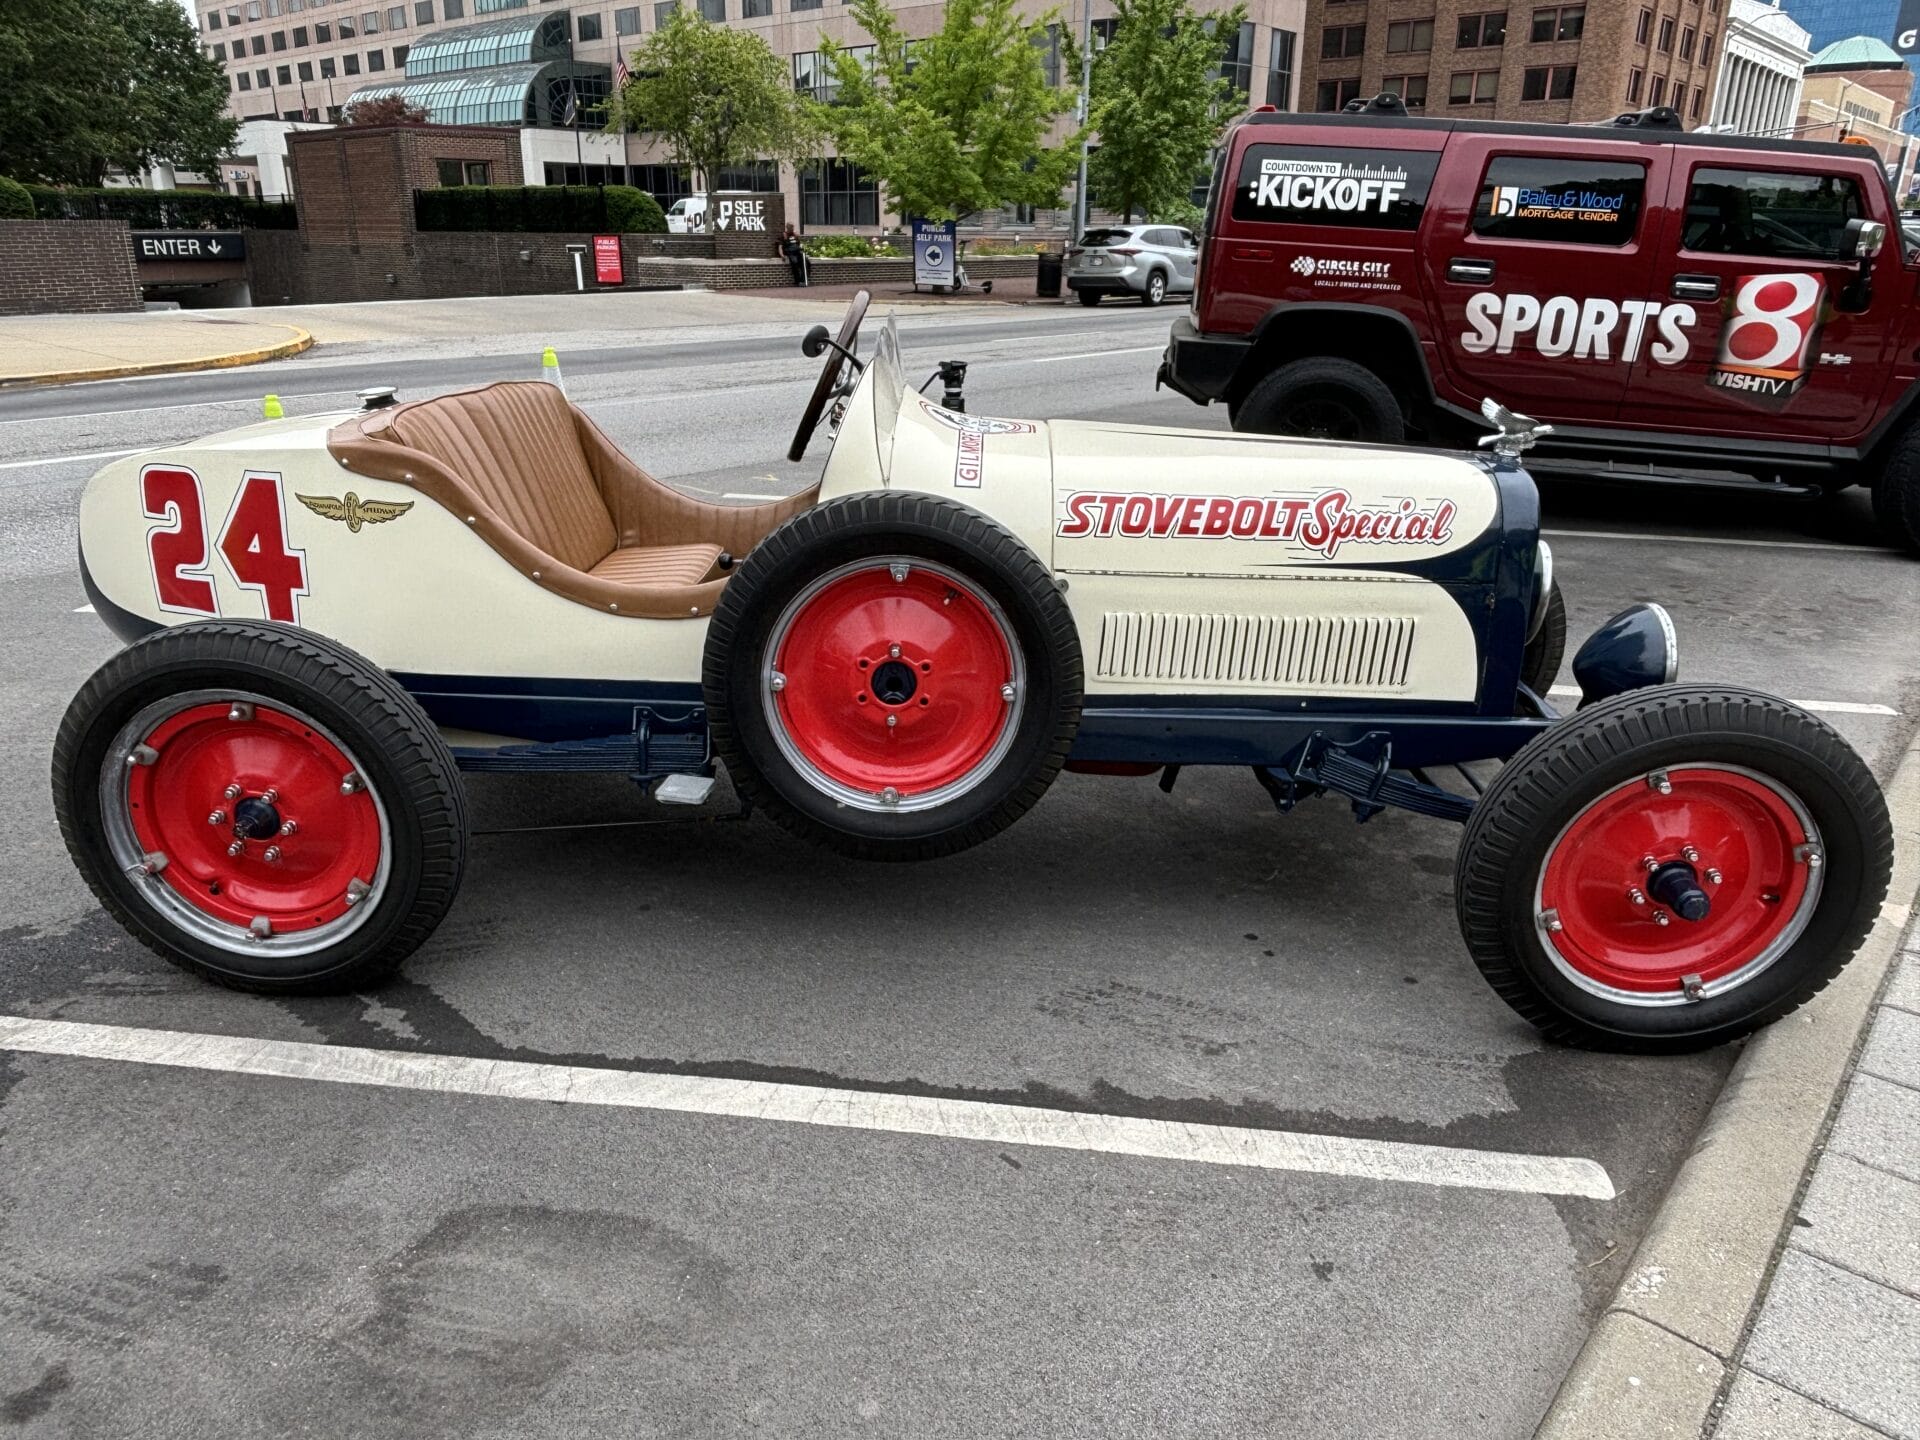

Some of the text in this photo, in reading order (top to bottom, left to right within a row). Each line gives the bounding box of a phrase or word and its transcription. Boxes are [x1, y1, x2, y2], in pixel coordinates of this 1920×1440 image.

[1898, 29, 1918, 48] G
[1265, 162, 1337, 174] COUNTDOWN TO
[1518, 188, 1623, 209] Bailey & Wood
[735, 200, 764, 215] SELF
[1518, 208, 1618, 222] MORTGAGE LENDER
[735, 216, 765, 231] PARK
[916, 233, 952, 242] SELF PARK
[142, 239, 201, 255] ENTER
[1316, 269, 1389, 278] BROADCASTING
[1317, 259, 1391, 273] CIRCLE CITY
[1372, 283, 1402, 291] OPERATED
[1461, 292, 1697, 365] SPORTS
[1719, 273, 1819, 369] 8
[1058, 490, 1454, 557] STOVEBOLT Special
[141, 467, 307, 625] 24
